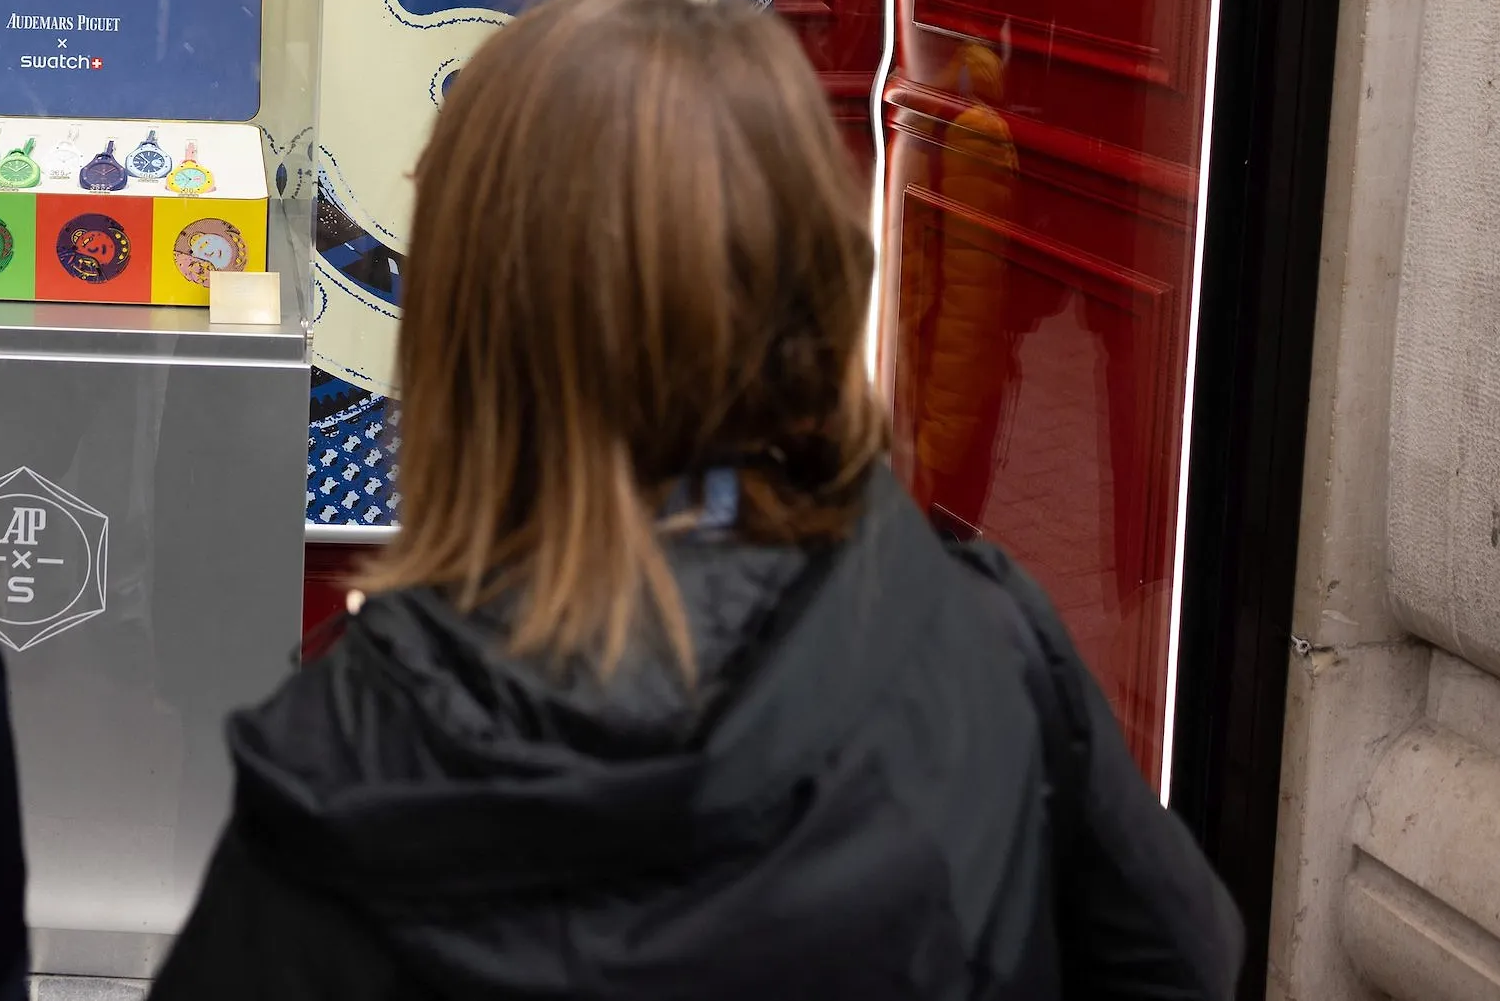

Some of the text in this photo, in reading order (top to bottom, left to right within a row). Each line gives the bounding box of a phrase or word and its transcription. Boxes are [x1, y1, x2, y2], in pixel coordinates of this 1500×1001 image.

[6, 12, 121, 32] AUDEMARS PIGUET
[20, 54, 90, 70] swatch
[0, 507, 47, 545] AP
[7, 576, 35, 603] S
